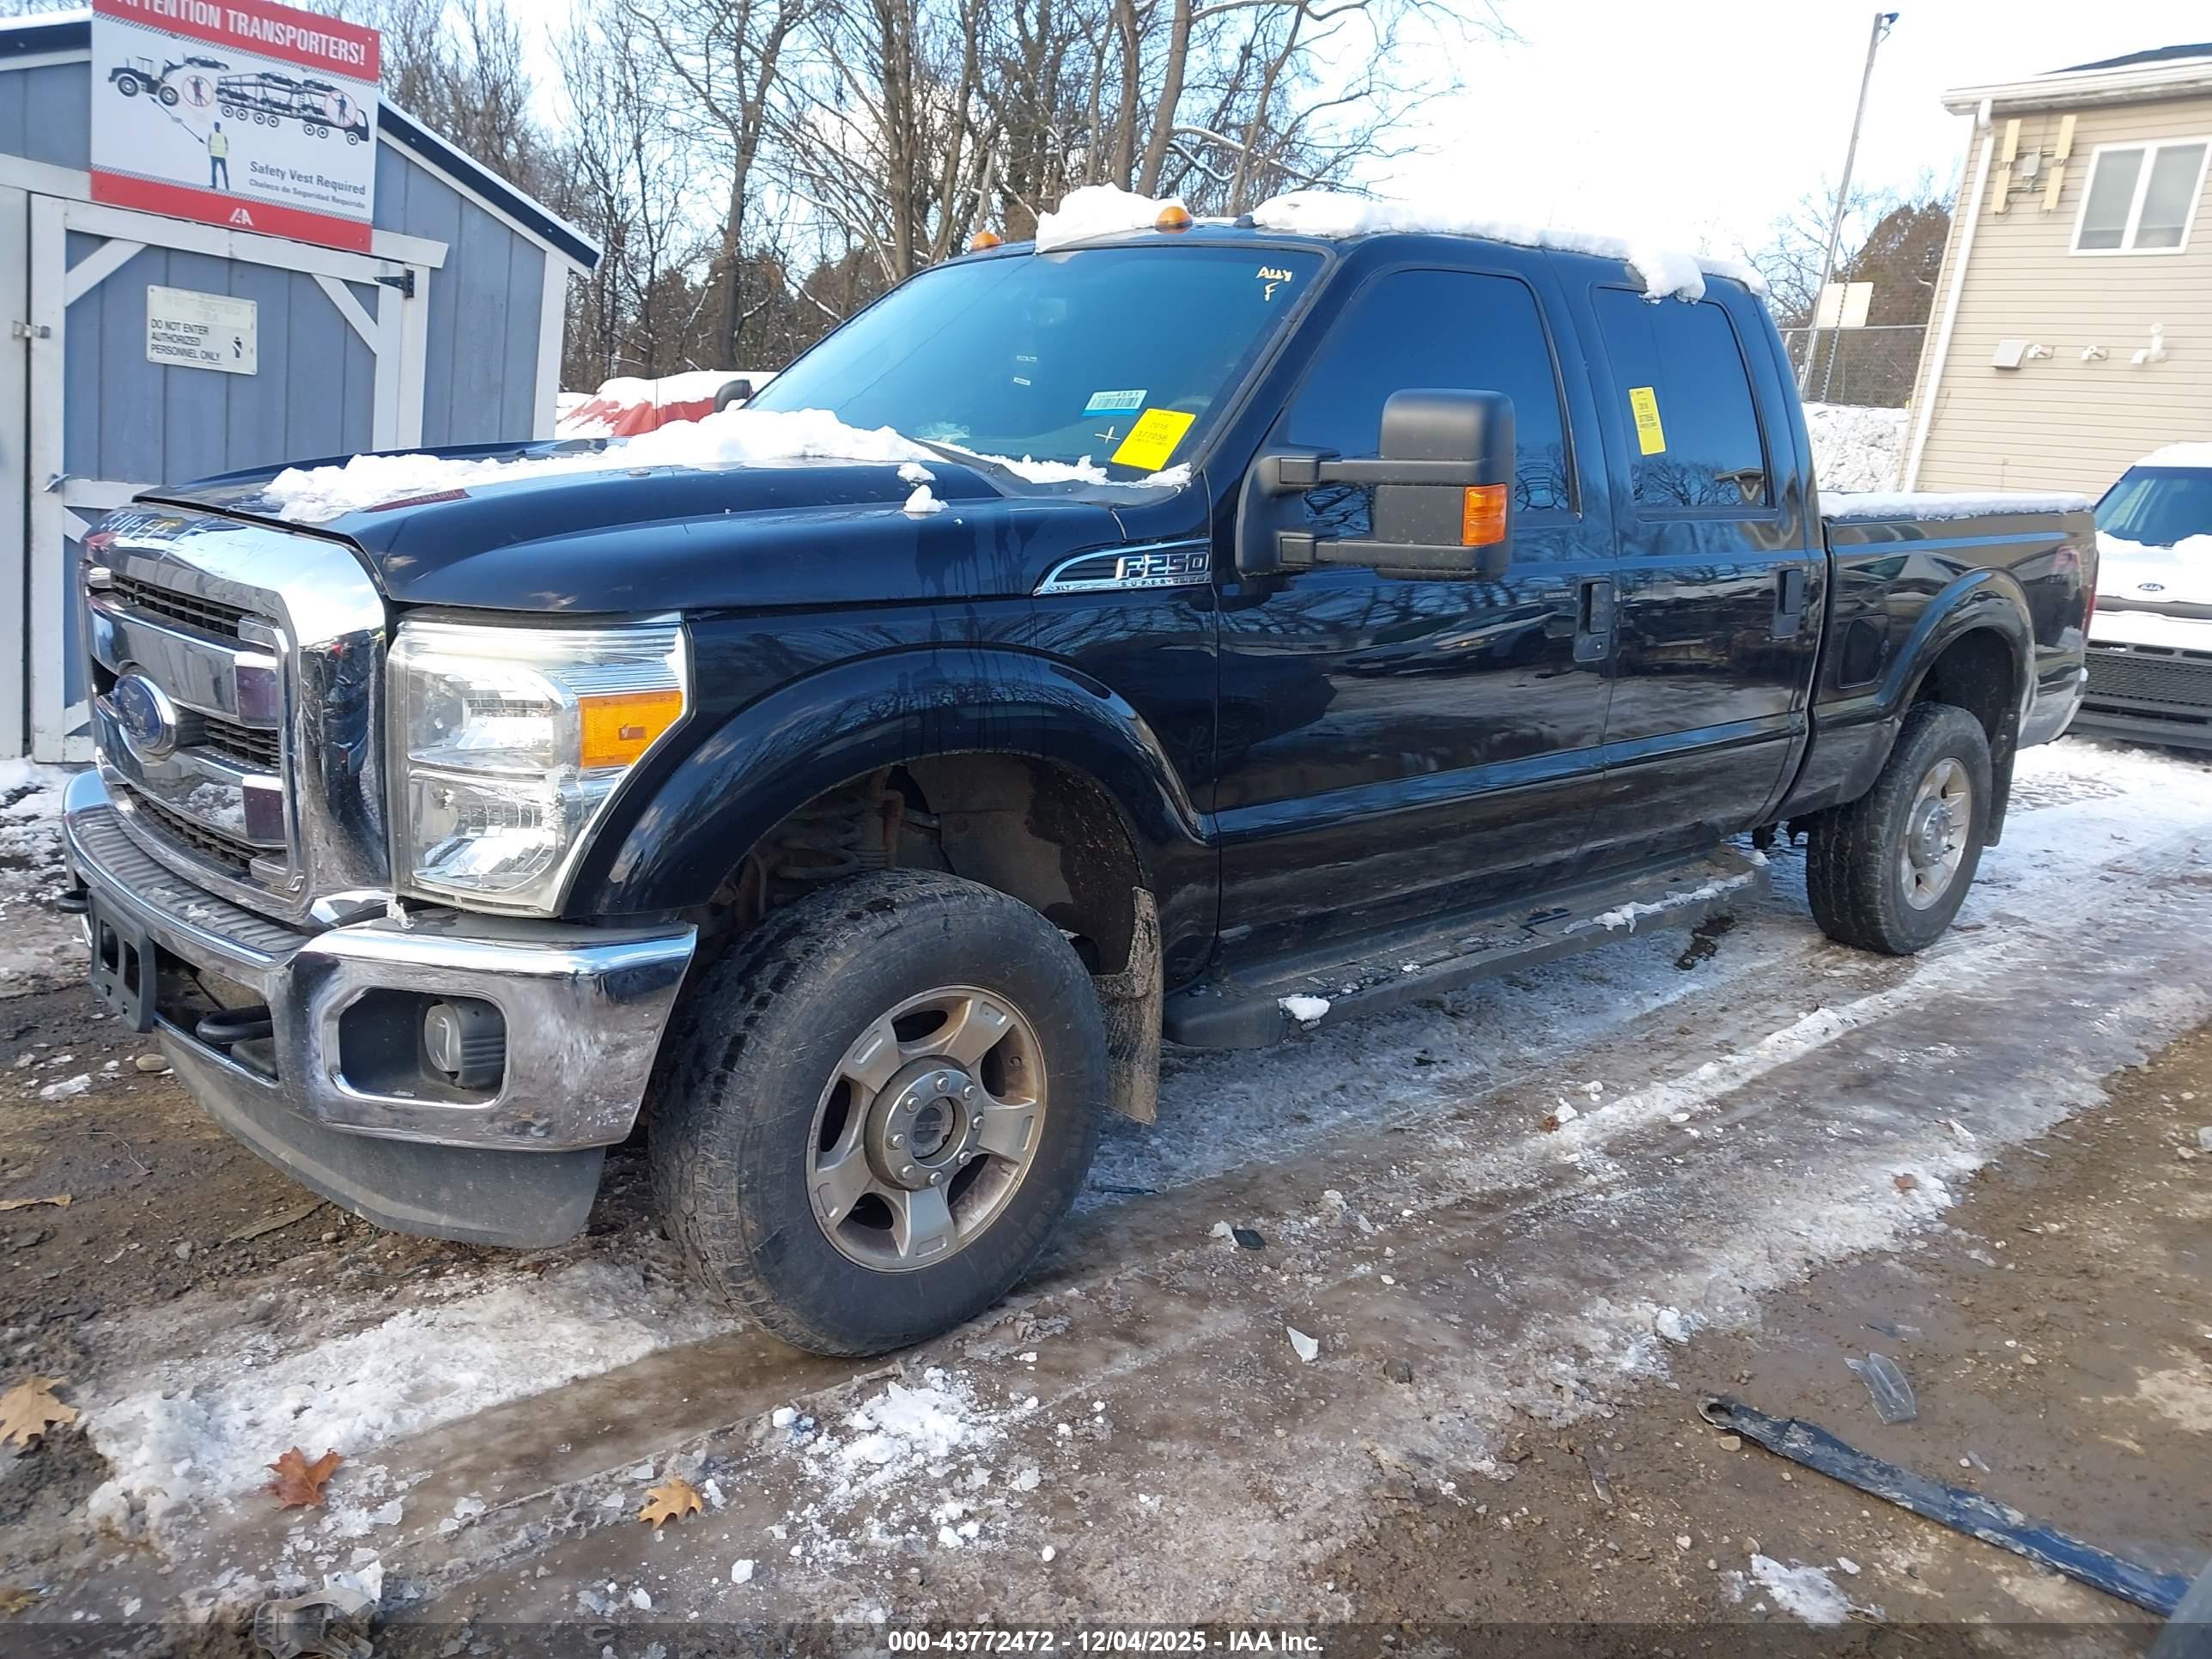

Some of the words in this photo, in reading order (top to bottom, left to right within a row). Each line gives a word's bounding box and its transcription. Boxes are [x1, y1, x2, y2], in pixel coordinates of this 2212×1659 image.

[117, 0, 221, 29] ENTION
[226, 9, 366, 66] TRANSPORTERS!
[250, 161, 286, 180] Safety
[289, 169, 313, 185] Vest
[317, 175, 366, 196] Required
[151, 319, 163, 329] DO
[165, 320, 180, 331] NOT
[183, 323, 209, 336] ENTER
[151, 331, 201, 346] AUTHORIZED
[151, 343, 198, 359] PERSONNEL
[200, 349, 220, 361] ONLY
